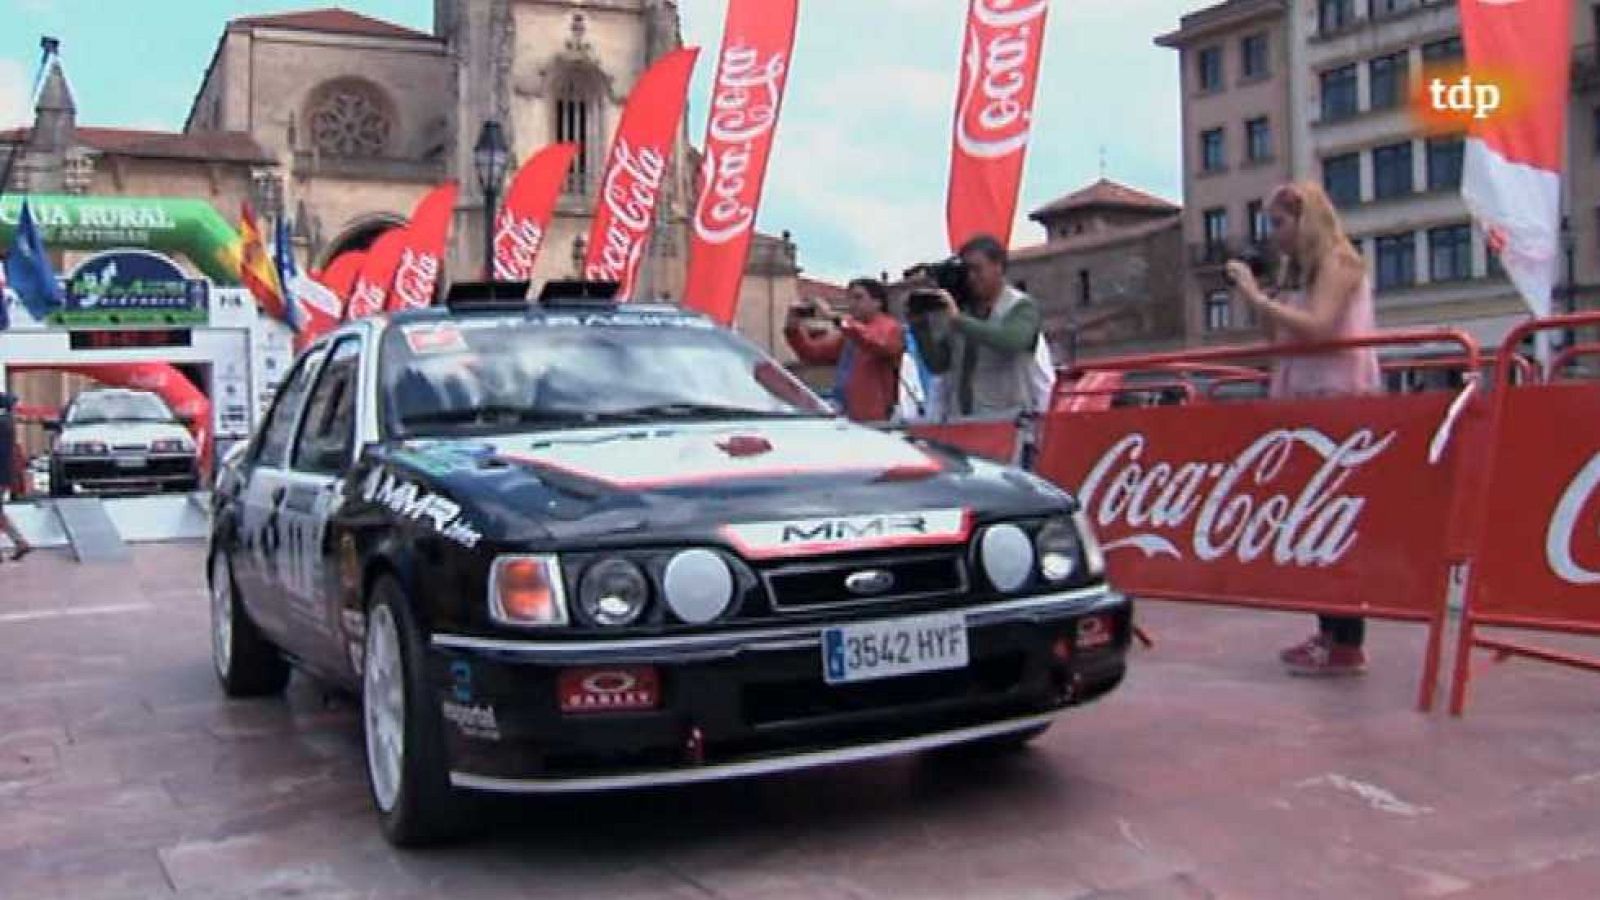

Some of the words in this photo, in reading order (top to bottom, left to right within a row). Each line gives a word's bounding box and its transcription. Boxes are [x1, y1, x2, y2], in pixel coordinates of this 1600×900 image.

[80, 206, 177, 229] RURAL
[782, 516, 927, 542] MMR
[847, 630, 911, 670] 3542
[917, 623, 961, 661] HYF
